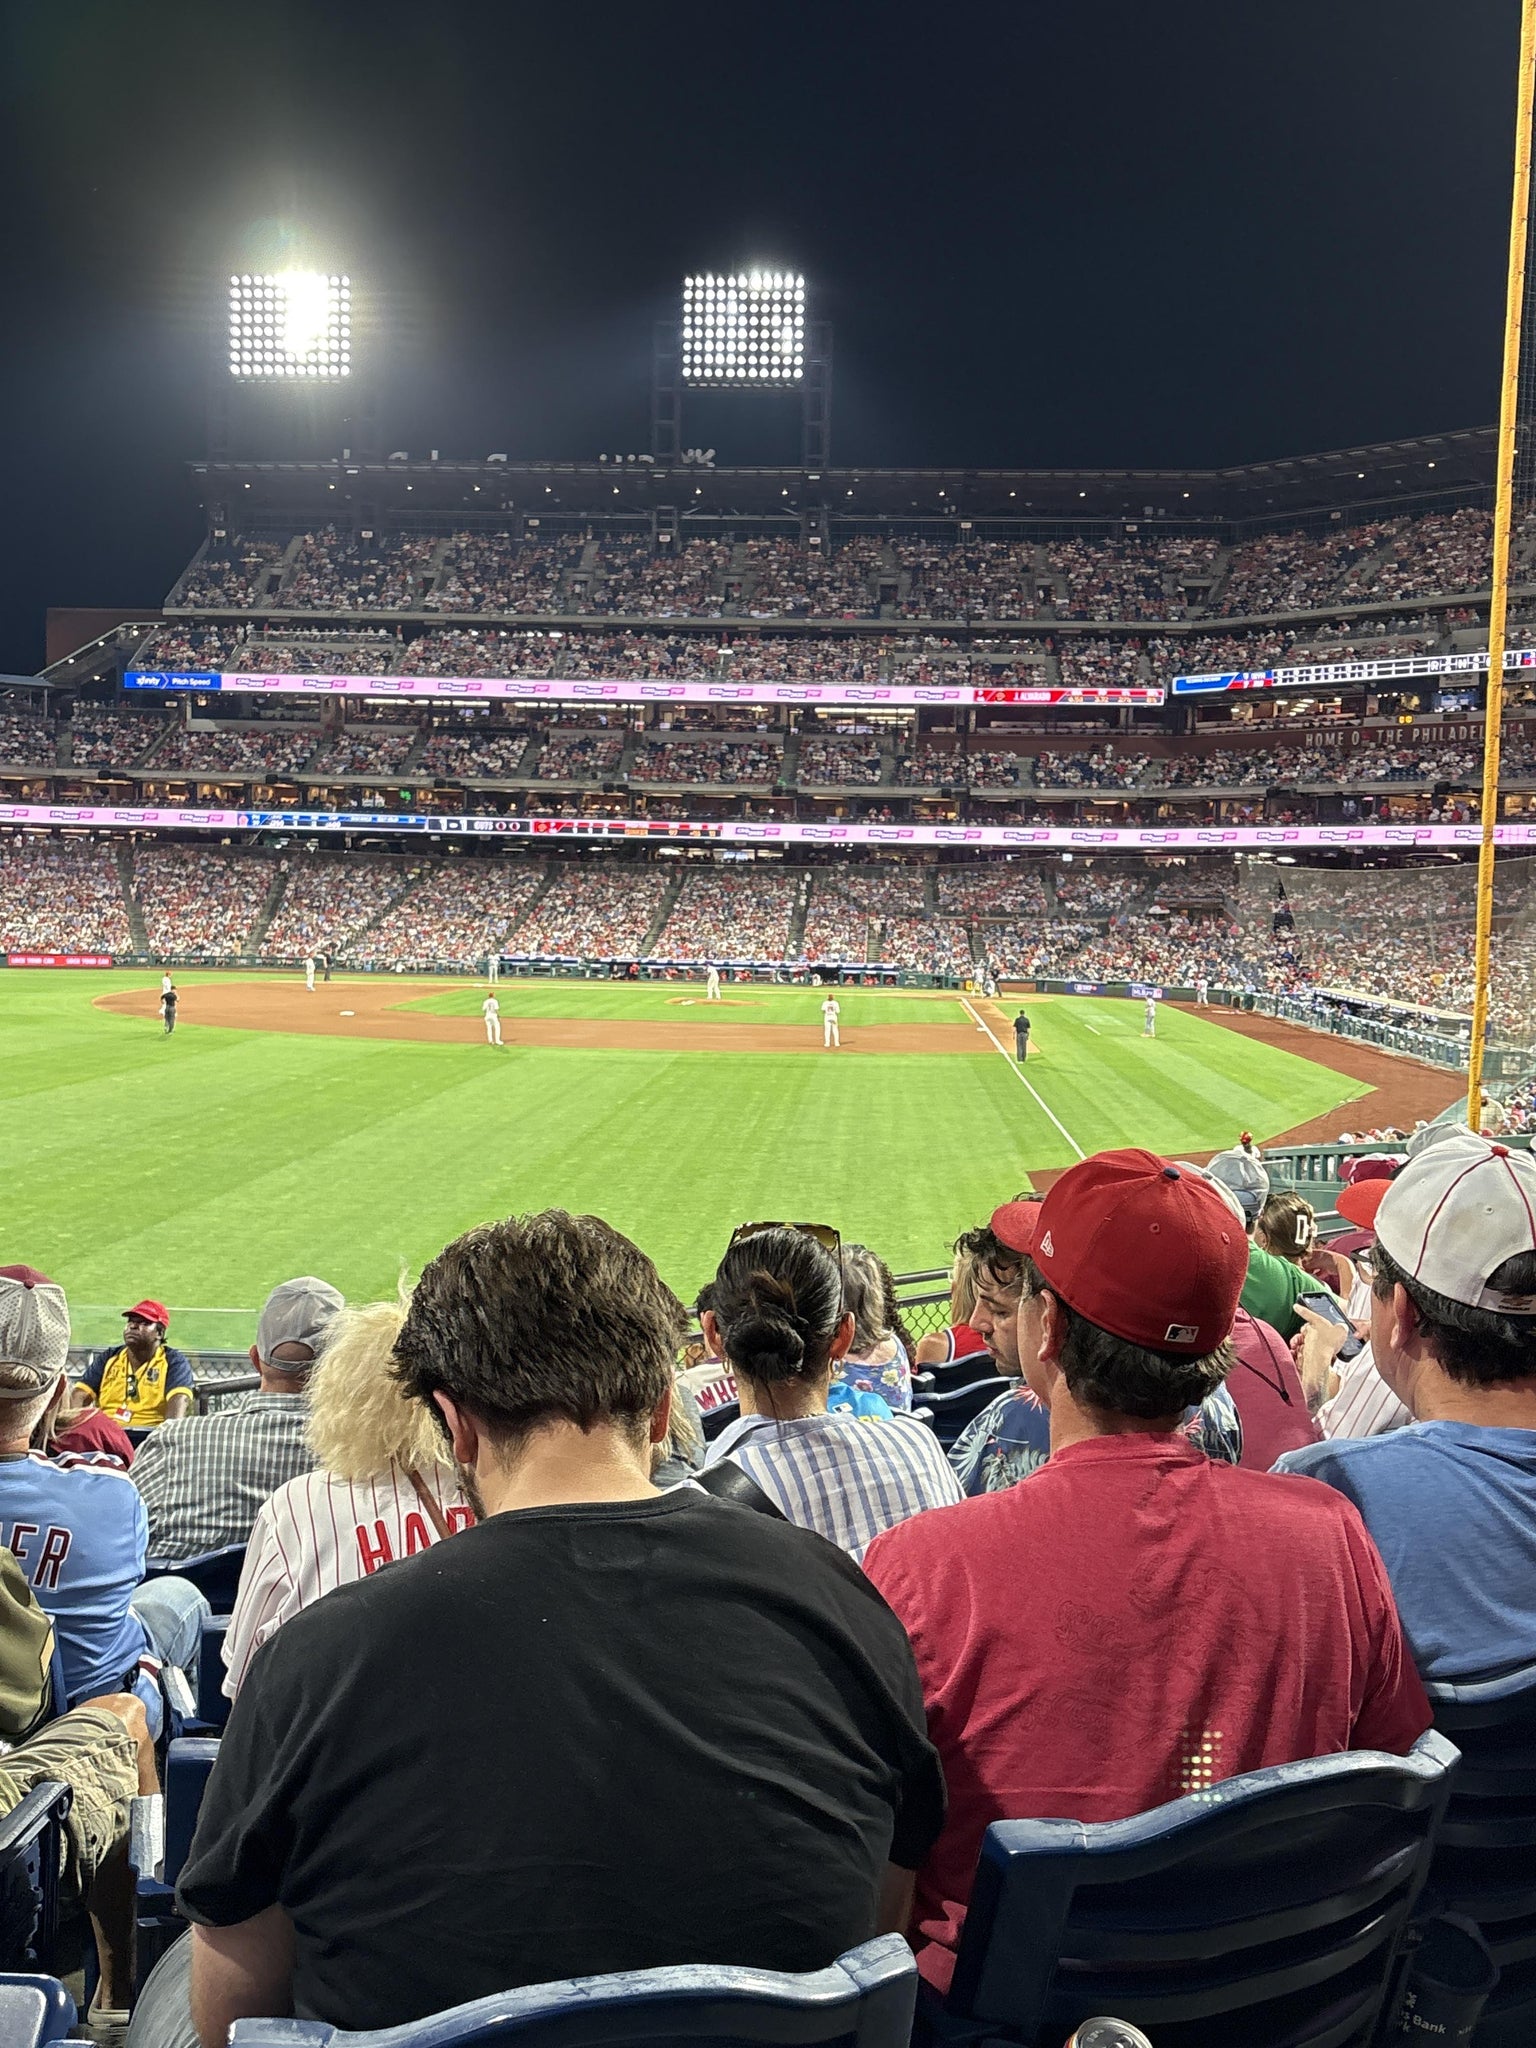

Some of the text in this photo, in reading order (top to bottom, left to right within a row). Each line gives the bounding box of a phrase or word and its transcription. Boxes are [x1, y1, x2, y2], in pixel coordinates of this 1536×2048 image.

[172, 677, 211, 687] Pitch Speed
[1305, 731, 1344, 747] HOME
[1375, 729, 1403, 744] THE
[1412, 2014, 1447, 2034] Bank
